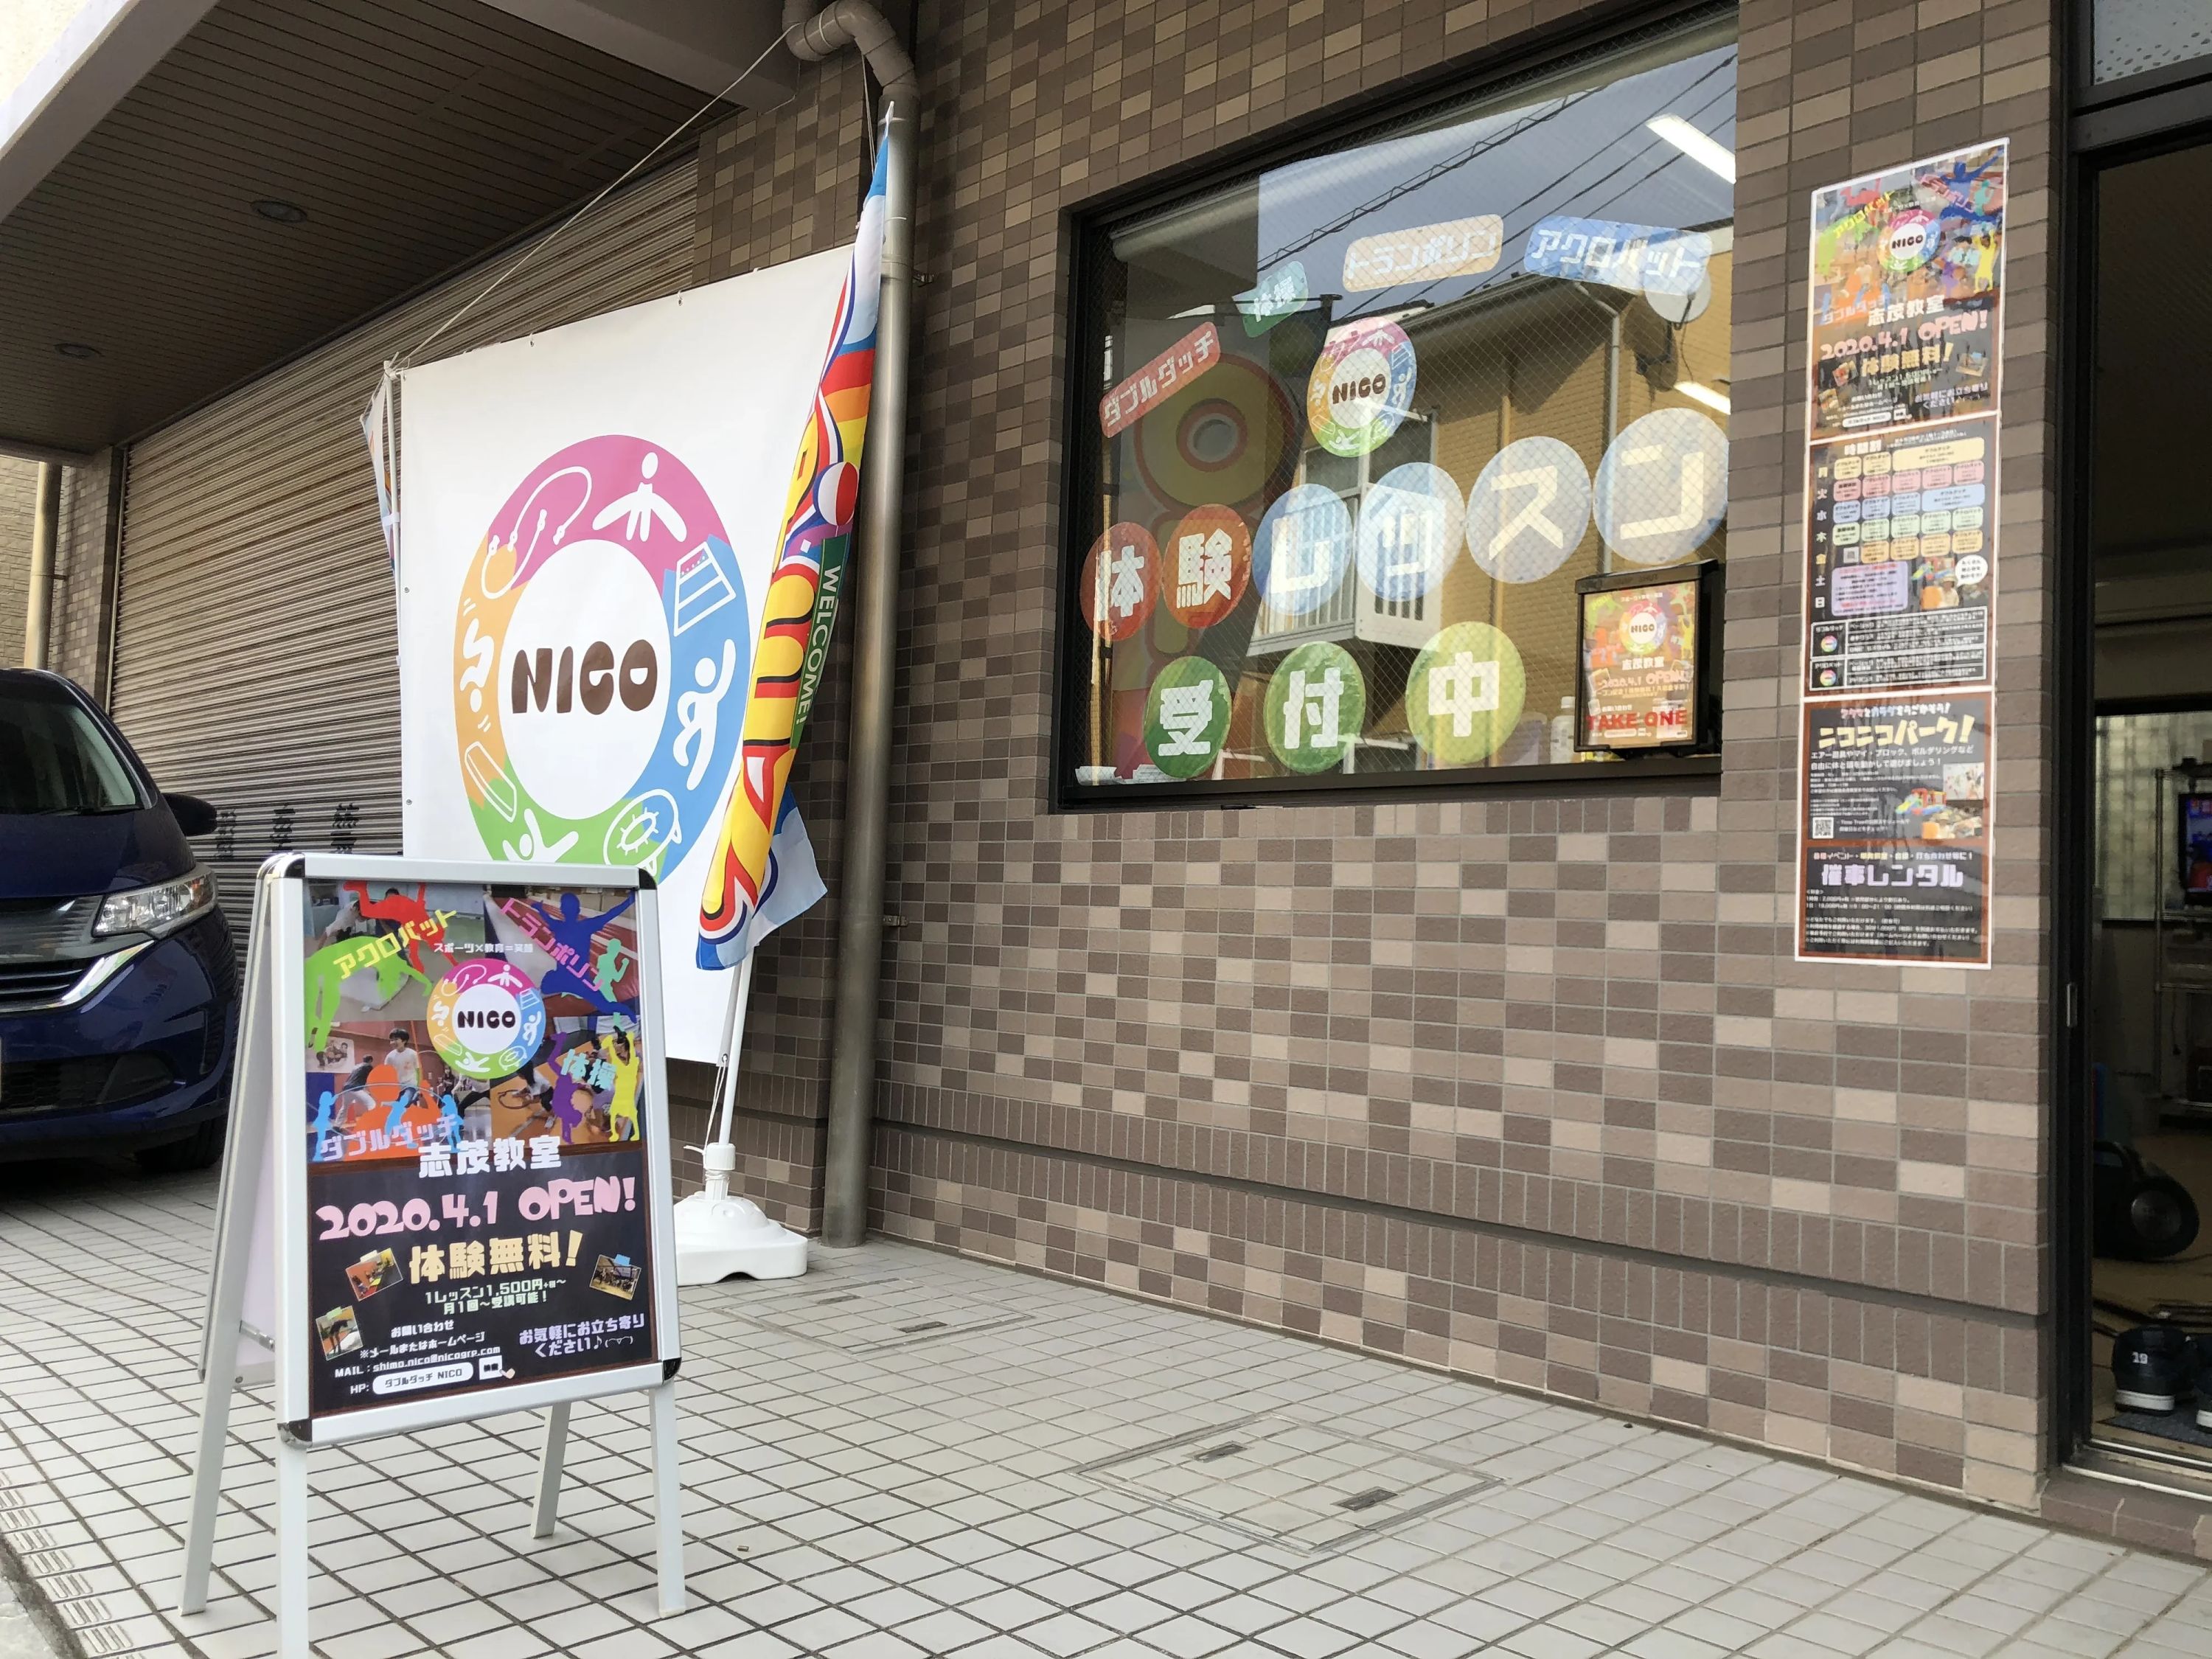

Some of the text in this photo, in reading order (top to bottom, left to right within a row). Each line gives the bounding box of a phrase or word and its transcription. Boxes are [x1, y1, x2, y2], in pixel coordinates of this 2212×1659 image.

[1346, 231, 1499, 279] トランポリン
[1531, 229, 1703, 279] アクロバット
[1891, 234, 1924, 250] NICO
[1820, 309, 1989, 361] 2020.4.1 OPEN!
[1104, 330, 1217, 428] ダブルダッチ
[1332, 373, 1387, 406] NICO
[794, 566, 842, 726] WELCOME!
[1630, 624, 1655, 633] NICO
[511, 639, 658, 715] NICO
[1158, 650, 1500, 757] 受付中
[1586, 709, 1688, 731] TAKE ONE
[333, 908, 457, 981] アクロバット
[500, 897, 606, 992] トランポリン
[456, 1010, 516, 1029] NICO
[320, 1114, 458, 1161] ダブルダッチ
[418, 1135, 562, 1178] 志茂教室
[315, 1176, 636, 1241] 2020.4.1 OPEN!
[390, 1319, 455, 1339] お問い合わせ
[518, 1313, 646, 1346] お気軽にお立ち寄り
[437, 1368, 463, 1380] NICO
